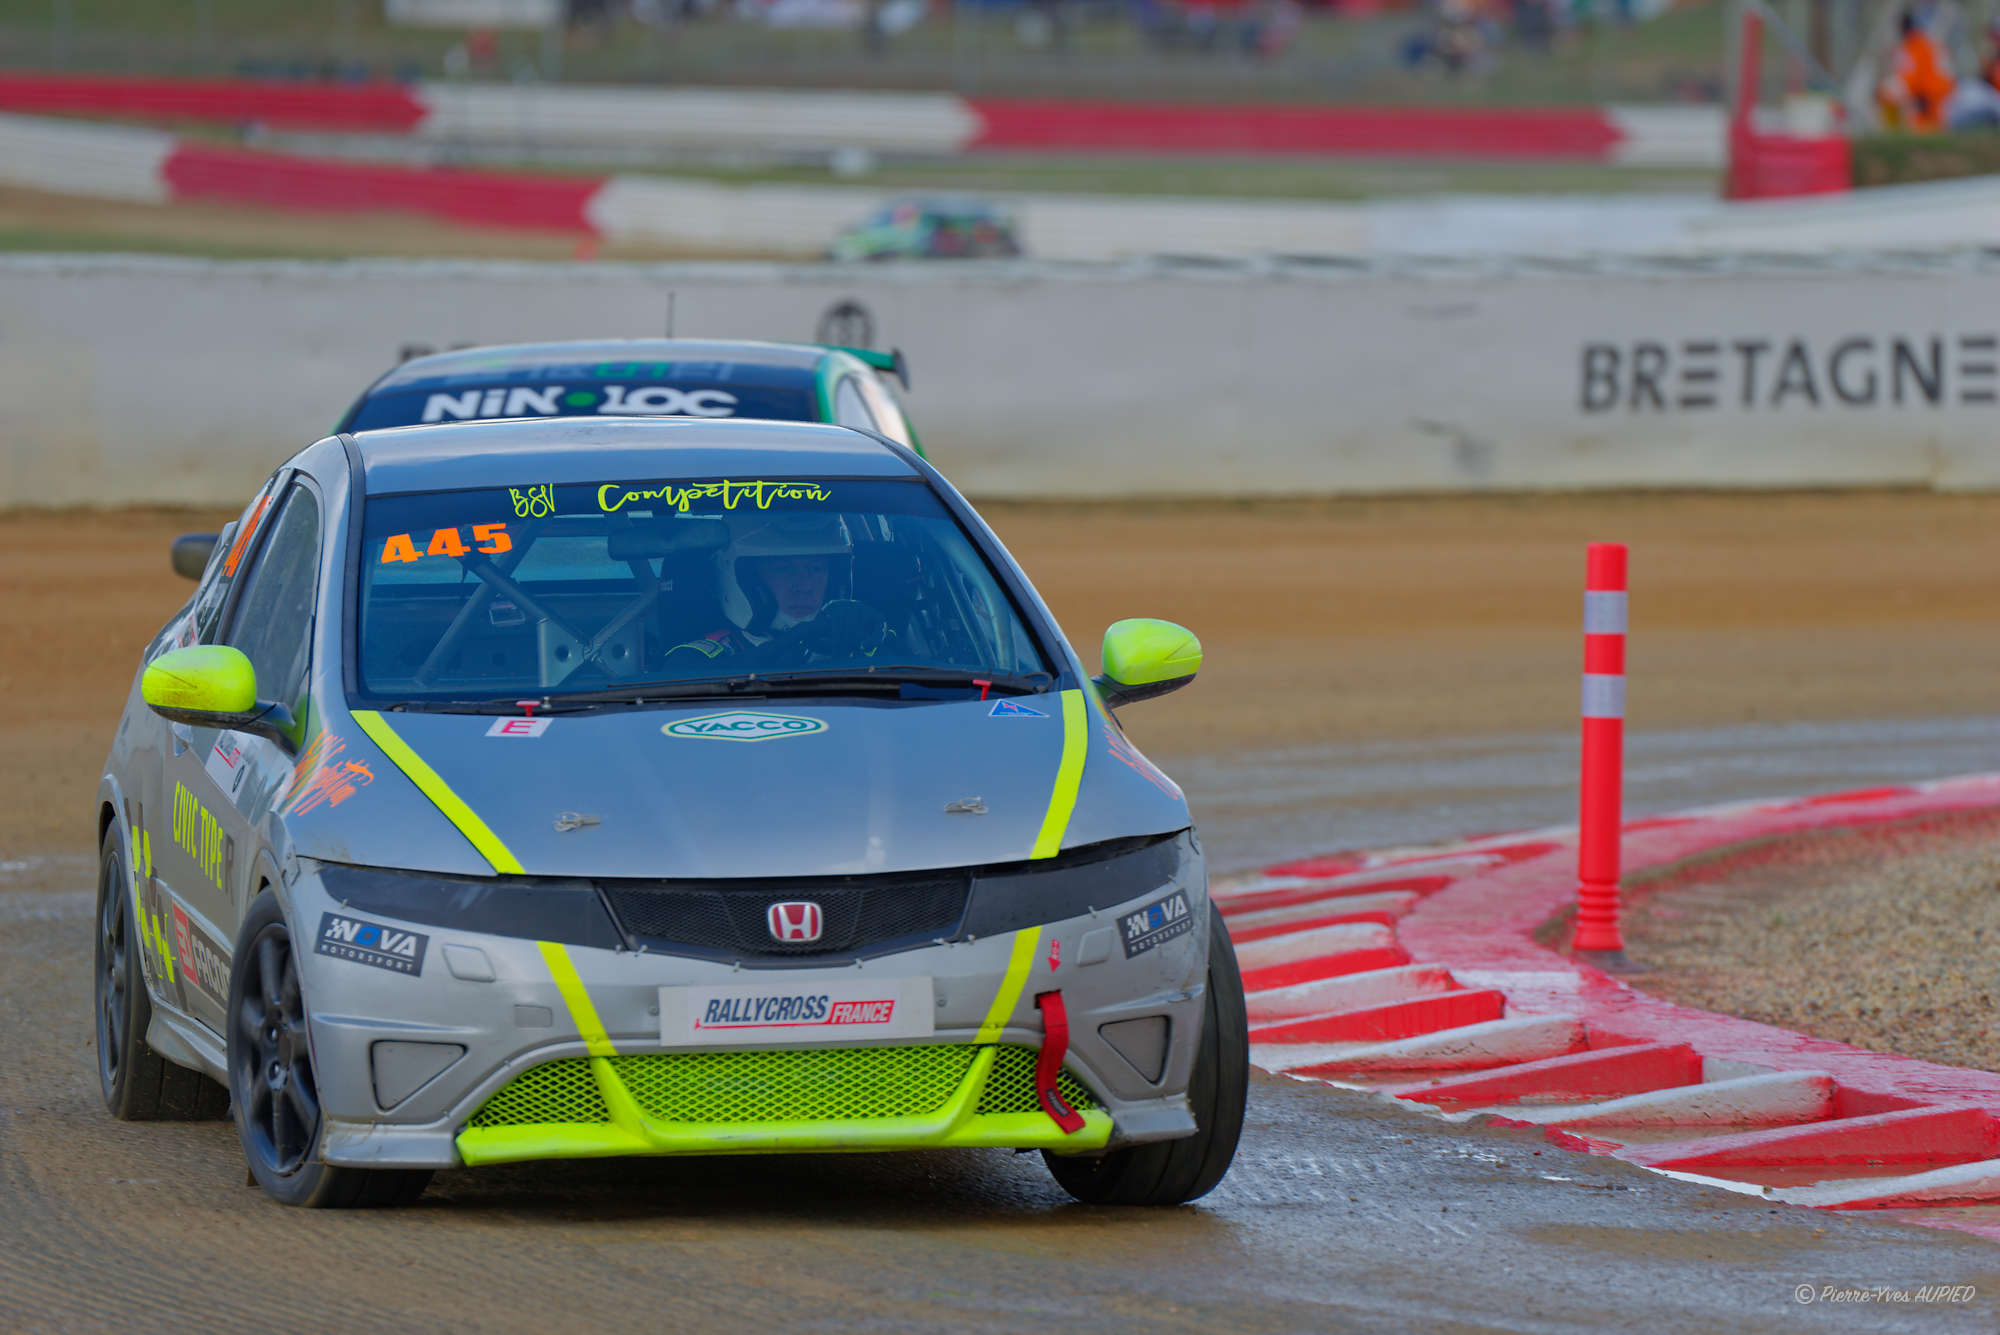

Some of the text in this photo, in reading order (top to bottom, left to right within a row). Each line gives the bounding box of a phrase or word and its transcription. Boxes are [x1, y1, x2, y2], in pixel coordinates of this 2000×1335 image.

[1580, 337, 1998, 412] BRETAGNE
[598, 480, 831, 512] Competition
[381, 523, 512, 563] 445
[501, 720, 537, 734] E
[687, 719, 809, 733] YACCO
[173, 780, 198, 859] CIVIC
[200, 805, 223, 889] TYPE
[321, 944, 413, 971] MOTORSPORT
[703, 995, 892, 1024] RALLYCROSS FRANCE
